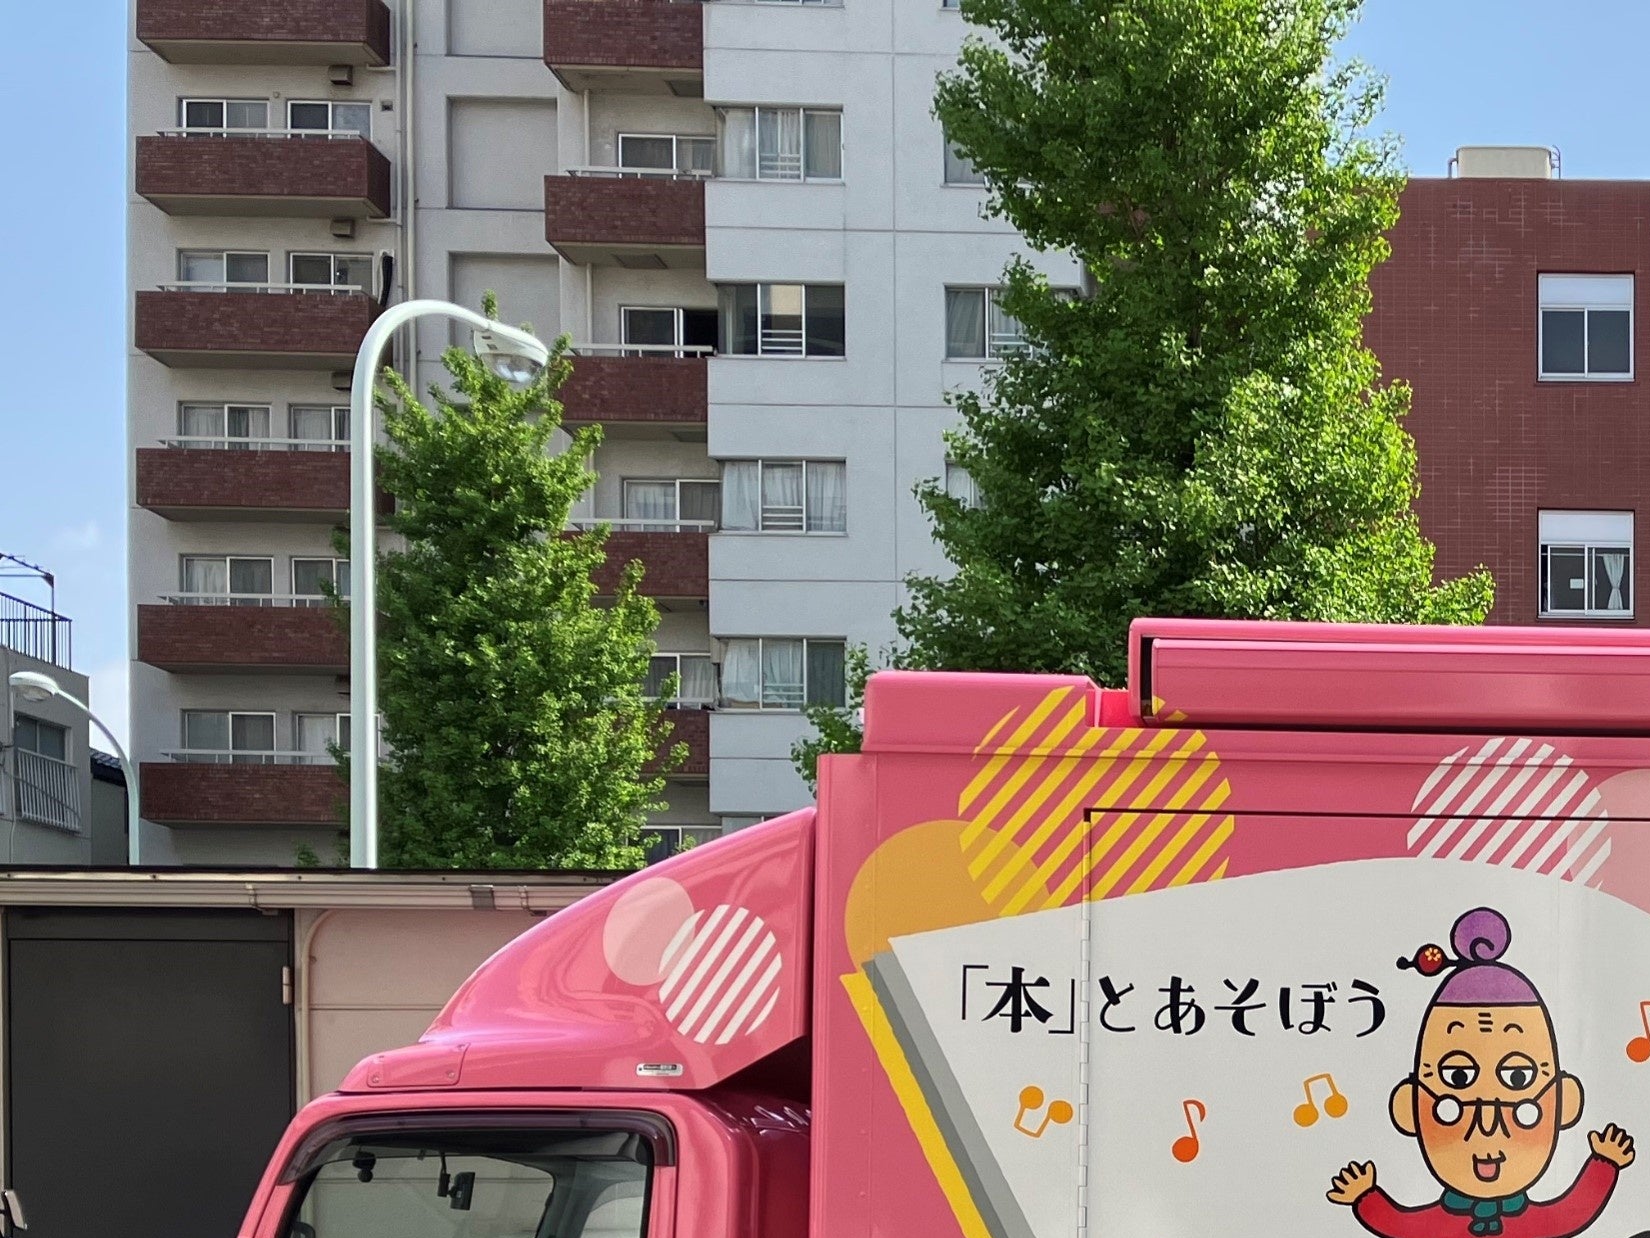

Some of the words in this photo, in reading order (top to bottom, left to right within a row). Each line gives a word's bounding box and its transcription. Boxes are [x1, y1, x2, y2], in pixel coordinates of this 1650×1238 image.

[961, 964, 1386, 1038] 「本」とあそぼう
